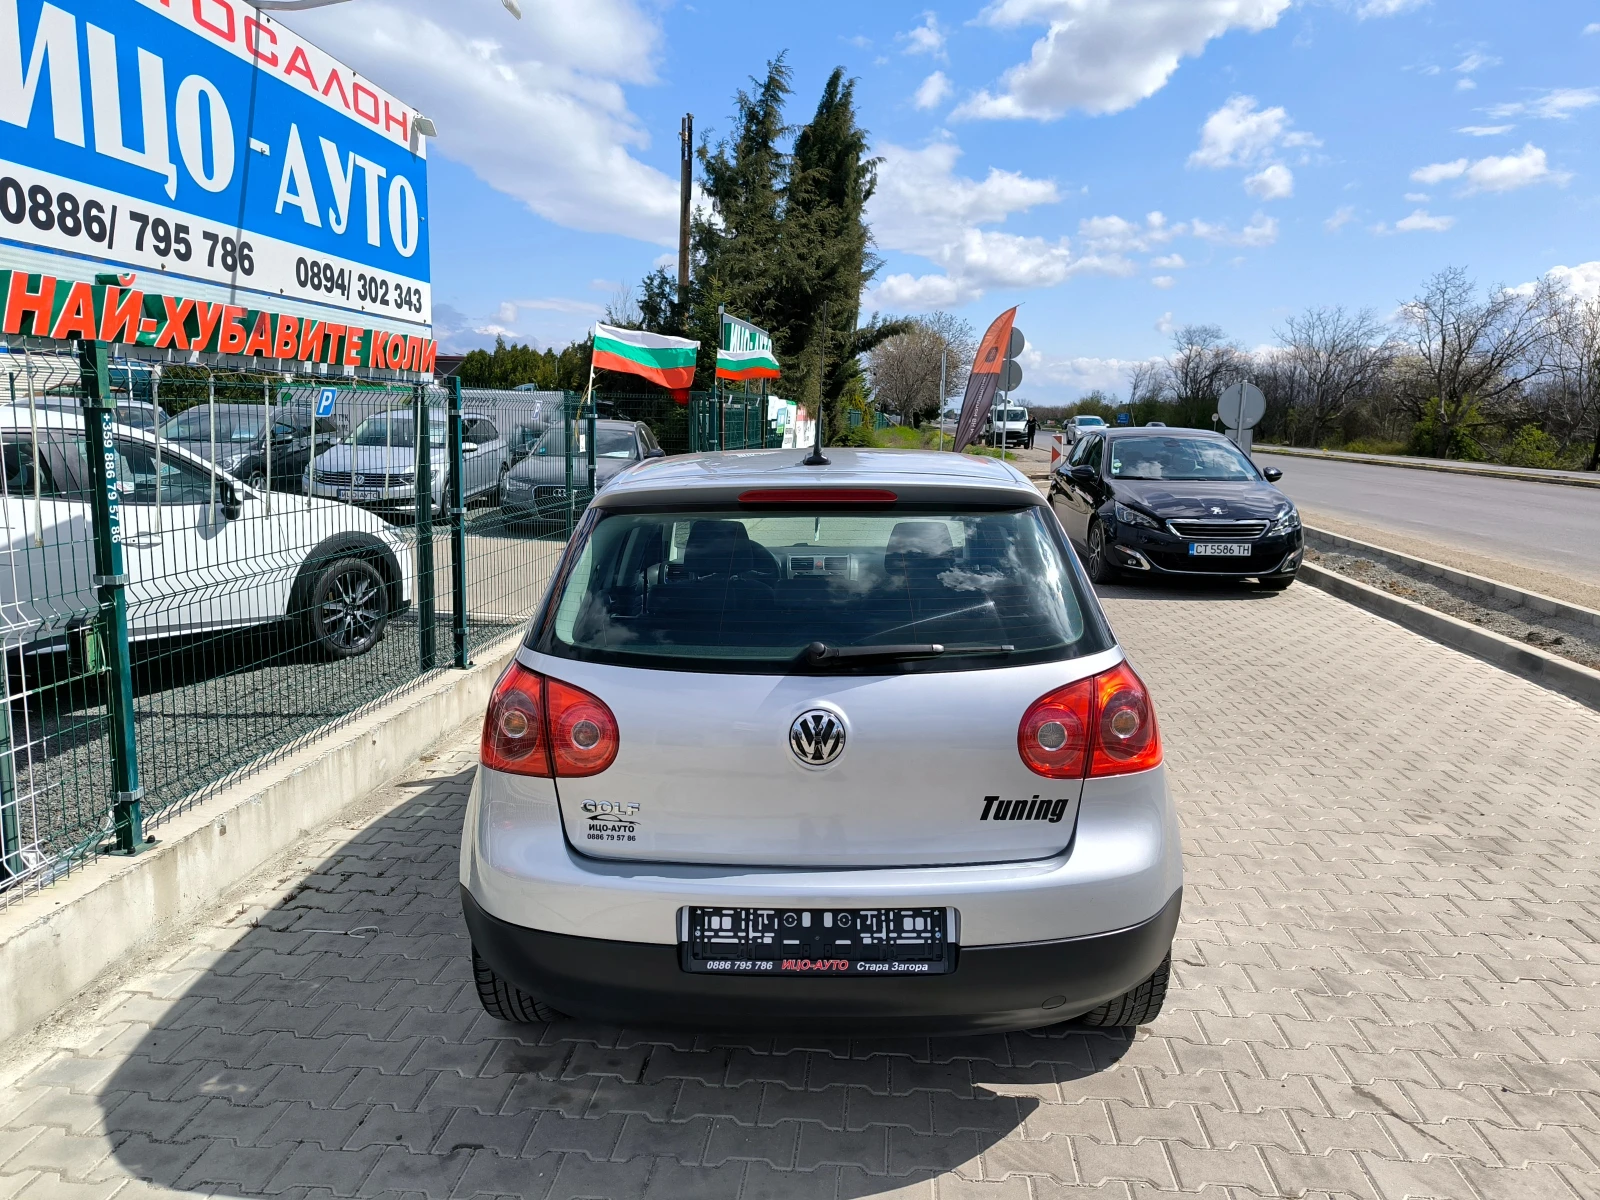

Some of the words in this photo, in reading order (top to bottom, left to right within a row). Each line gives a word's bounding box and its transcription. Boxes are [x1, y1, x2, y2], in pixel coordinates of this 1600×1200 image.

[160, 0, 409, 142] ОСАЛОН
[0, 177, 117, 250] 0886/
[129, 210, 192, 262] 795
[202, 230, 255, 276] 786
[296, 256, 352, 300] 0894/
[357, 273, 390, 307] 302
[394, 283, 422, 313] 343
[2, 269, 364, 367] НАЙ-ХУБАВИТЕ
[369, 329, 438, 373] КОЛИ
[319, 391, 333, 414] P
[102, 412, 114, 448] +359
[104, 452, 116, 479] 886
[107, 482, 117, 500] 79
[109, 505, 119, 521] 57
[111, 526, 121, 543] 86
[1195, 544, 1209, 554] CT
[1210, 544, 1234, 555] 5586
[1236, 545, 1250, 555] TH
[580, 799, 640, 816] GOLF
[980, 794, 1069, 823] Tuning
[587, 833, 604, 841] 0886
[588, 823, 635, 833] ИЦО-АУТО
[707, 961, 731, 970] 0886
[734, 961, 752, 970] 795
[755, 961, 773, 970] 786
[782, 959, 849, 972] ИЦО-АУТО
[857, 962, 889, 972] Стара
[892, 962, 929, 972] Загора
